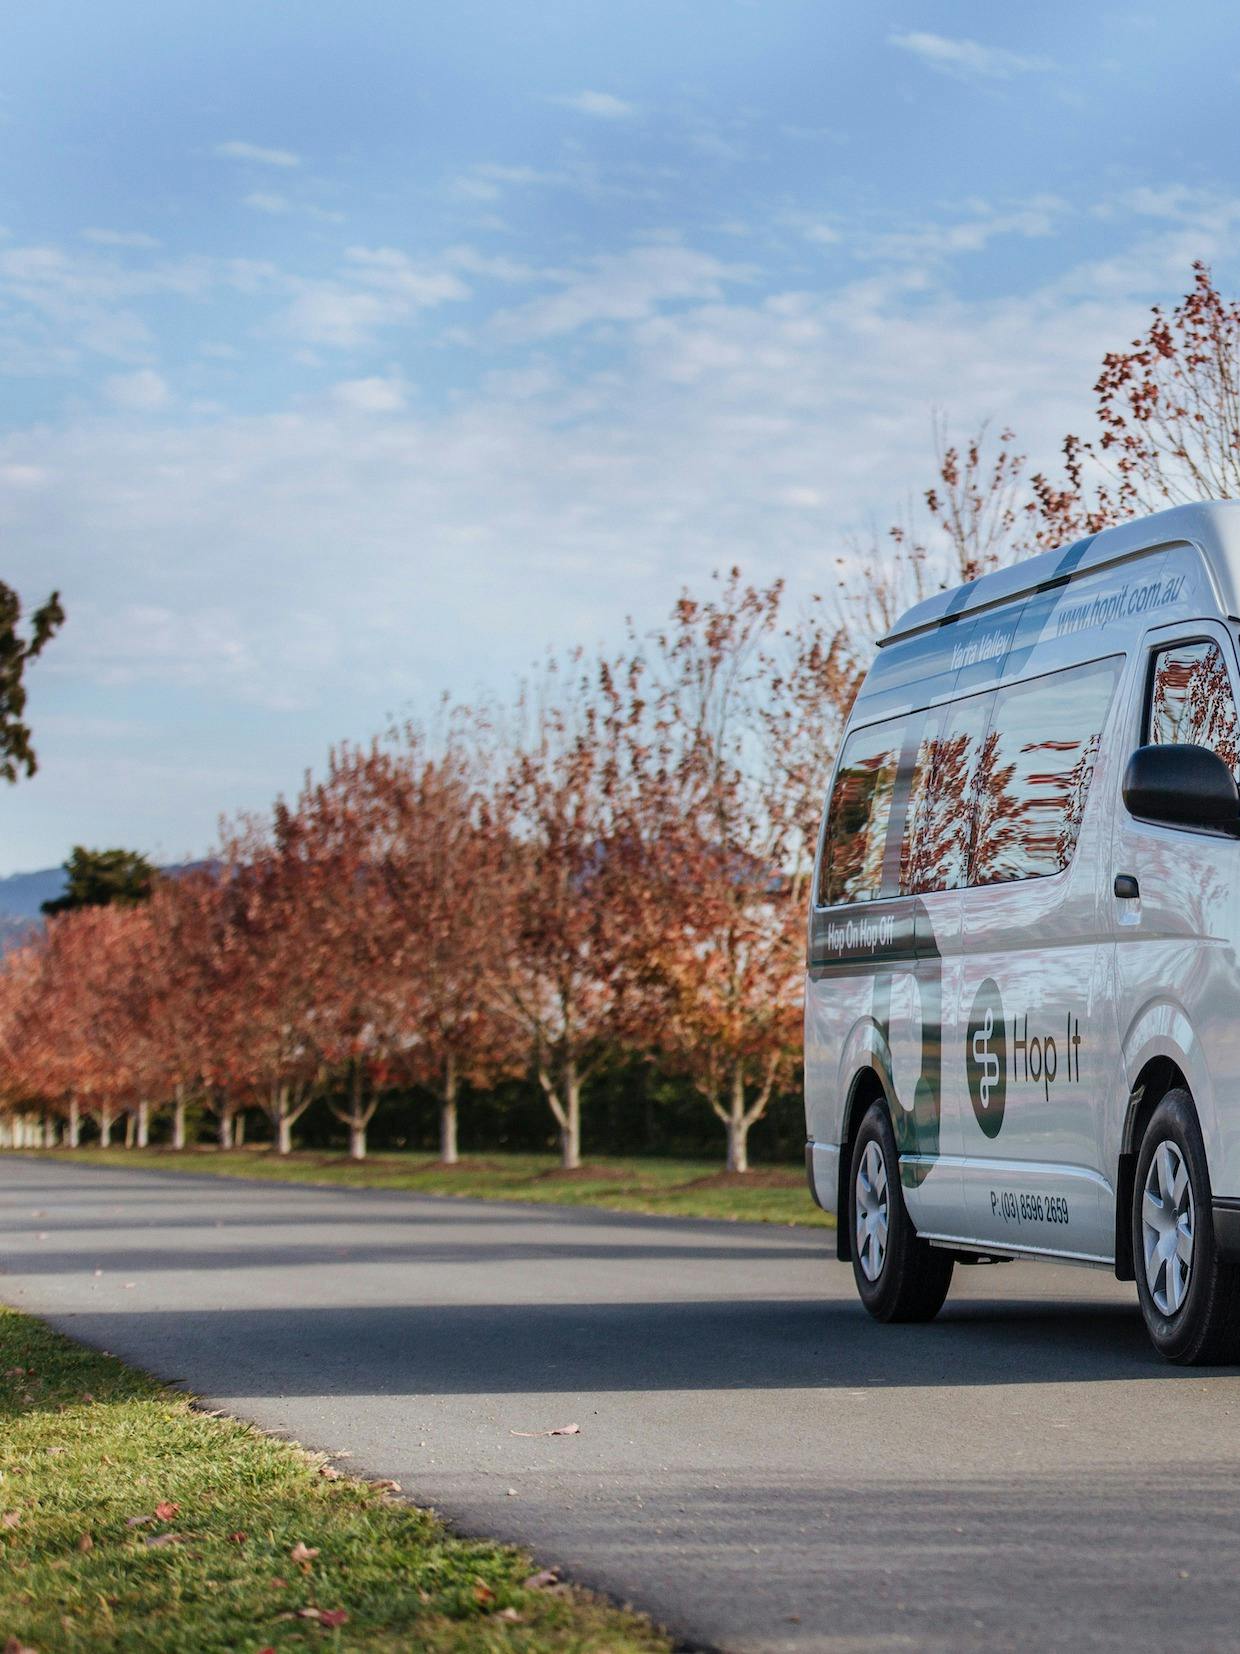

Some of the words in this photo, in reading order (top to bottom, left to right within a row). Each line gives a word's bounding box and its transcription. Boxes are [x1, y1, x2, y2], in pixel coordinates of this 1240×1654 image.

[1057, 576, 1185, 634] www.hopit.com.au
[951, 640, 978, 670] Yarra
[979, 629, 1011, 664] Valley
[827, 922, 845, 957] Hop
[846, 920, 859, 949] On
[859, 918, 878, 954] Hop
[879, 915, 895, 946] Off
[1013, 1014, 1058, 1102] Hop
[1067, 1010, 1082, 1083] It
[1001, 1192, 1021, 1225] (03)
[1020, 1194, 1044, 1222] 8596
[1044, 1196, 1069, 1224] 2659
